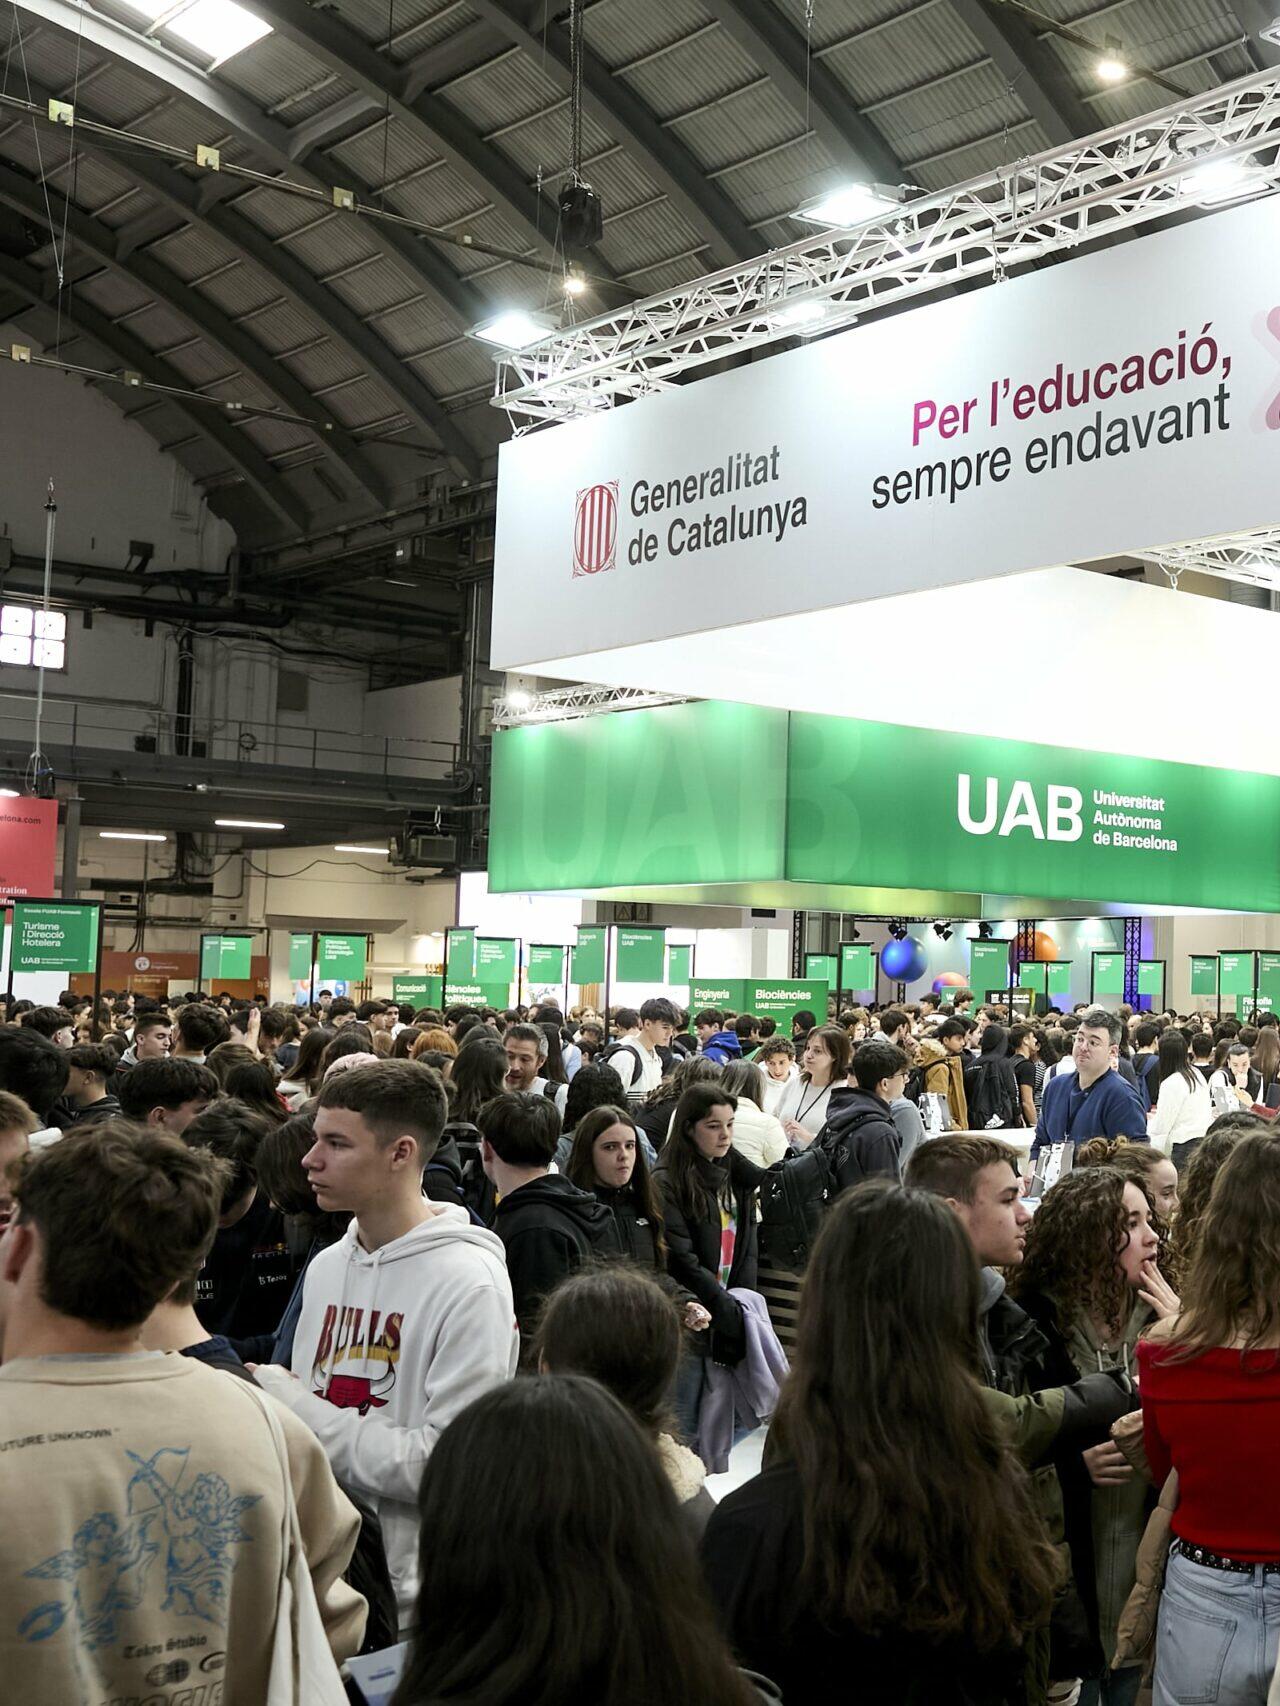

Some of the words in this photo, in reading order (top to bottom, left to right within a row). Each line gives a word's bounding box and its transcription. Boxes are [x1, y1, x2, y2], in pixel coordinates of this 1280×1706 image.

[912, 398, 977, 446] Per
[871, 444, 1012, 509] sempre
[1025, 382, 1231, 474] endavant
[630, 445, 780, 517] Generalitat
[628, 529, 658, 565] de
[667, 496, 808, 557] Catalunya
[958, 773, 1083, 842] UAB
[1093, 789, 1165, 812] Universitat
[1093, 810, 1162, 831] Autònoma
[1093, 830, 1110, 846] de
[1113, 832, 1178, 852] Barcelona
[22, 922, 60, 931] Turisme
[27, 930, 65, 939] Direcció
[22, 939, 61, 947] Hotelera
[21, 957, 40, 965] UAB
[694, 988, 730, 1001] Enginyeria
[755, 989, 812, 1000] Biociències
[755, 1002, 769, 1010] UAB
[314, 1304, 404, 1364] BULLS
[0, 1434, 45, 1452] UTURE
[48, 1429, 112, 1442] UNKNOWN
